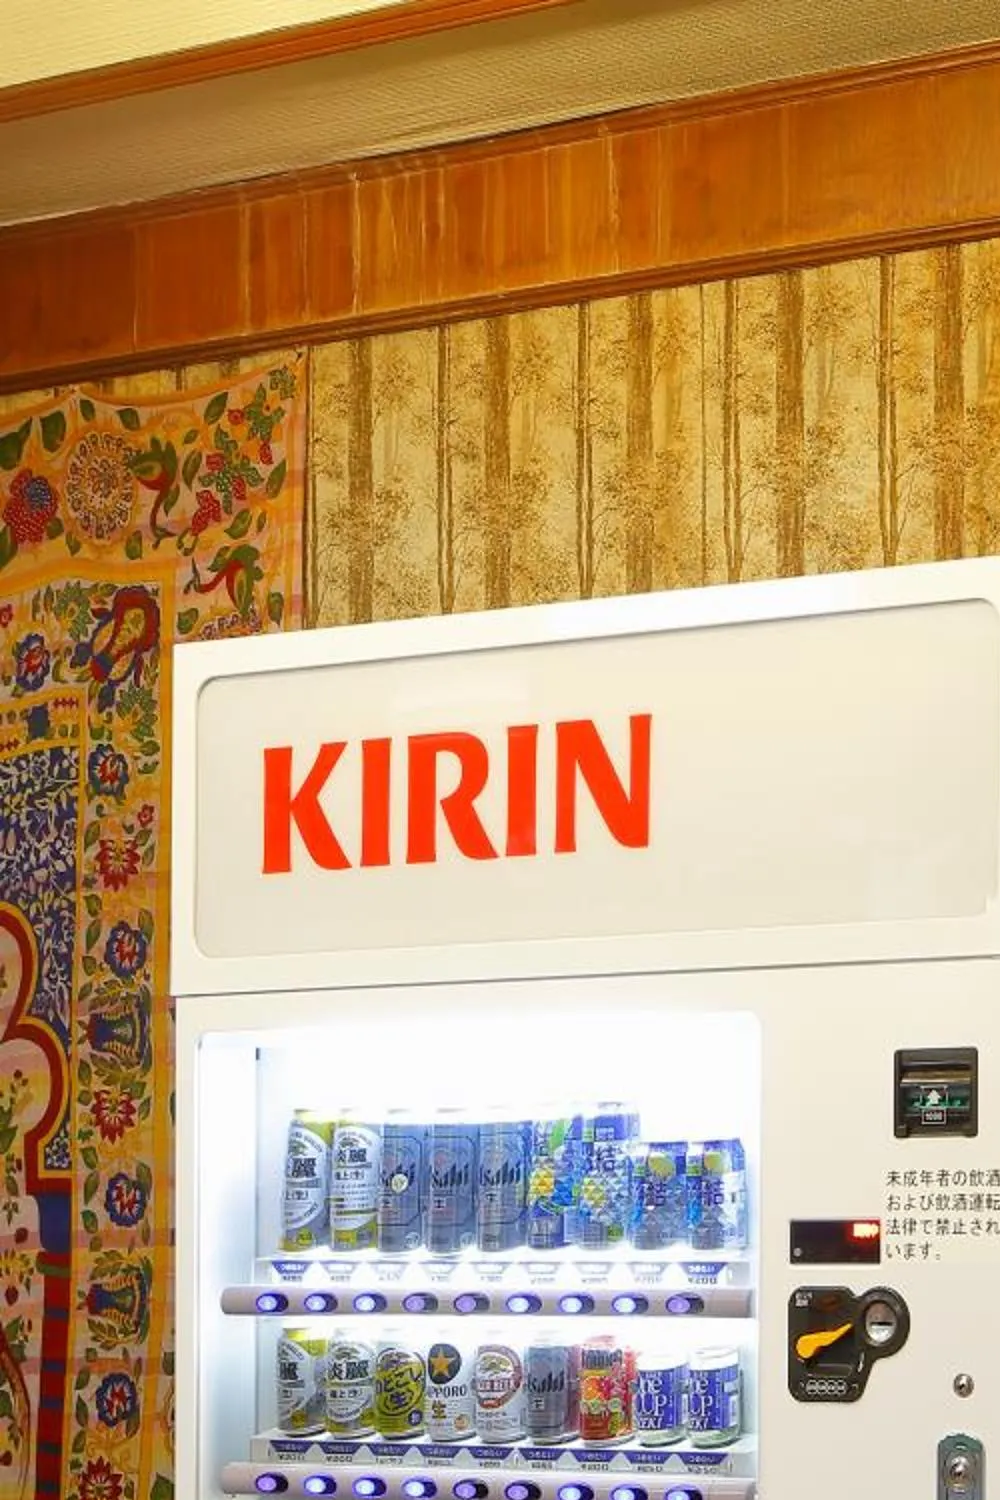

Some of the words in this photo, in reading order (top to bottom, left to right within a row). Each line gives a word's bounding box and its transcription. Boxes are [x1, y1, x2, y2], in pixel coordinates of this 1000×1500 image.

[262, 713, 652, 874] KIRIN
[886, 1241, 942, 1261] います。
